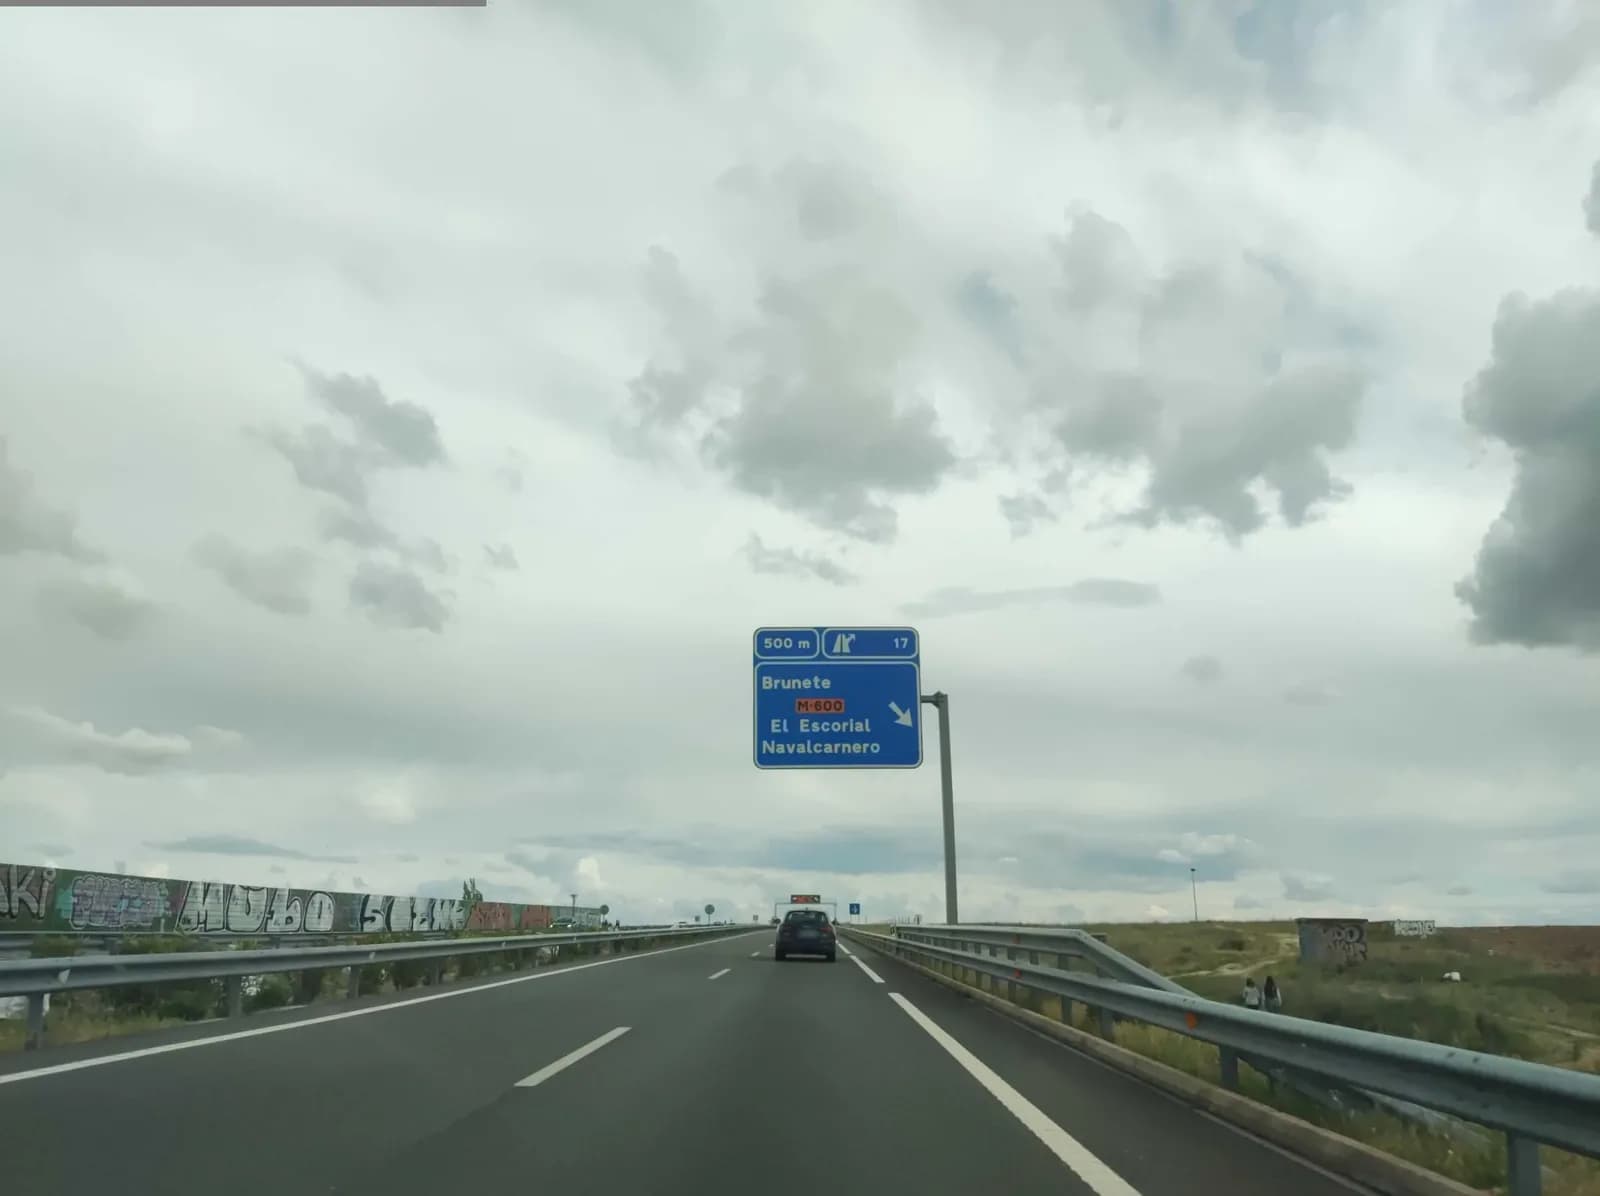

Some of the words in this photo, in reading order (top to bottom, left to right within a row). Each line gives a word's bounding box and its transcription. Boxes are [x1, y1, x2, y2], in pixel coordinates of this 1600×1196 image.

[764, 638, 793, 649] 500
[798, 640, 810, 649] m
[893, 638, 909, 649] 17
[762, 676, 831, 690] Brunete
[797, 700, 843, 712] M-600
[771, 719, 788, 732] El
[800, 718, 871, 733] Escorial
[762, 740, 880, 754] Navalcarnero
